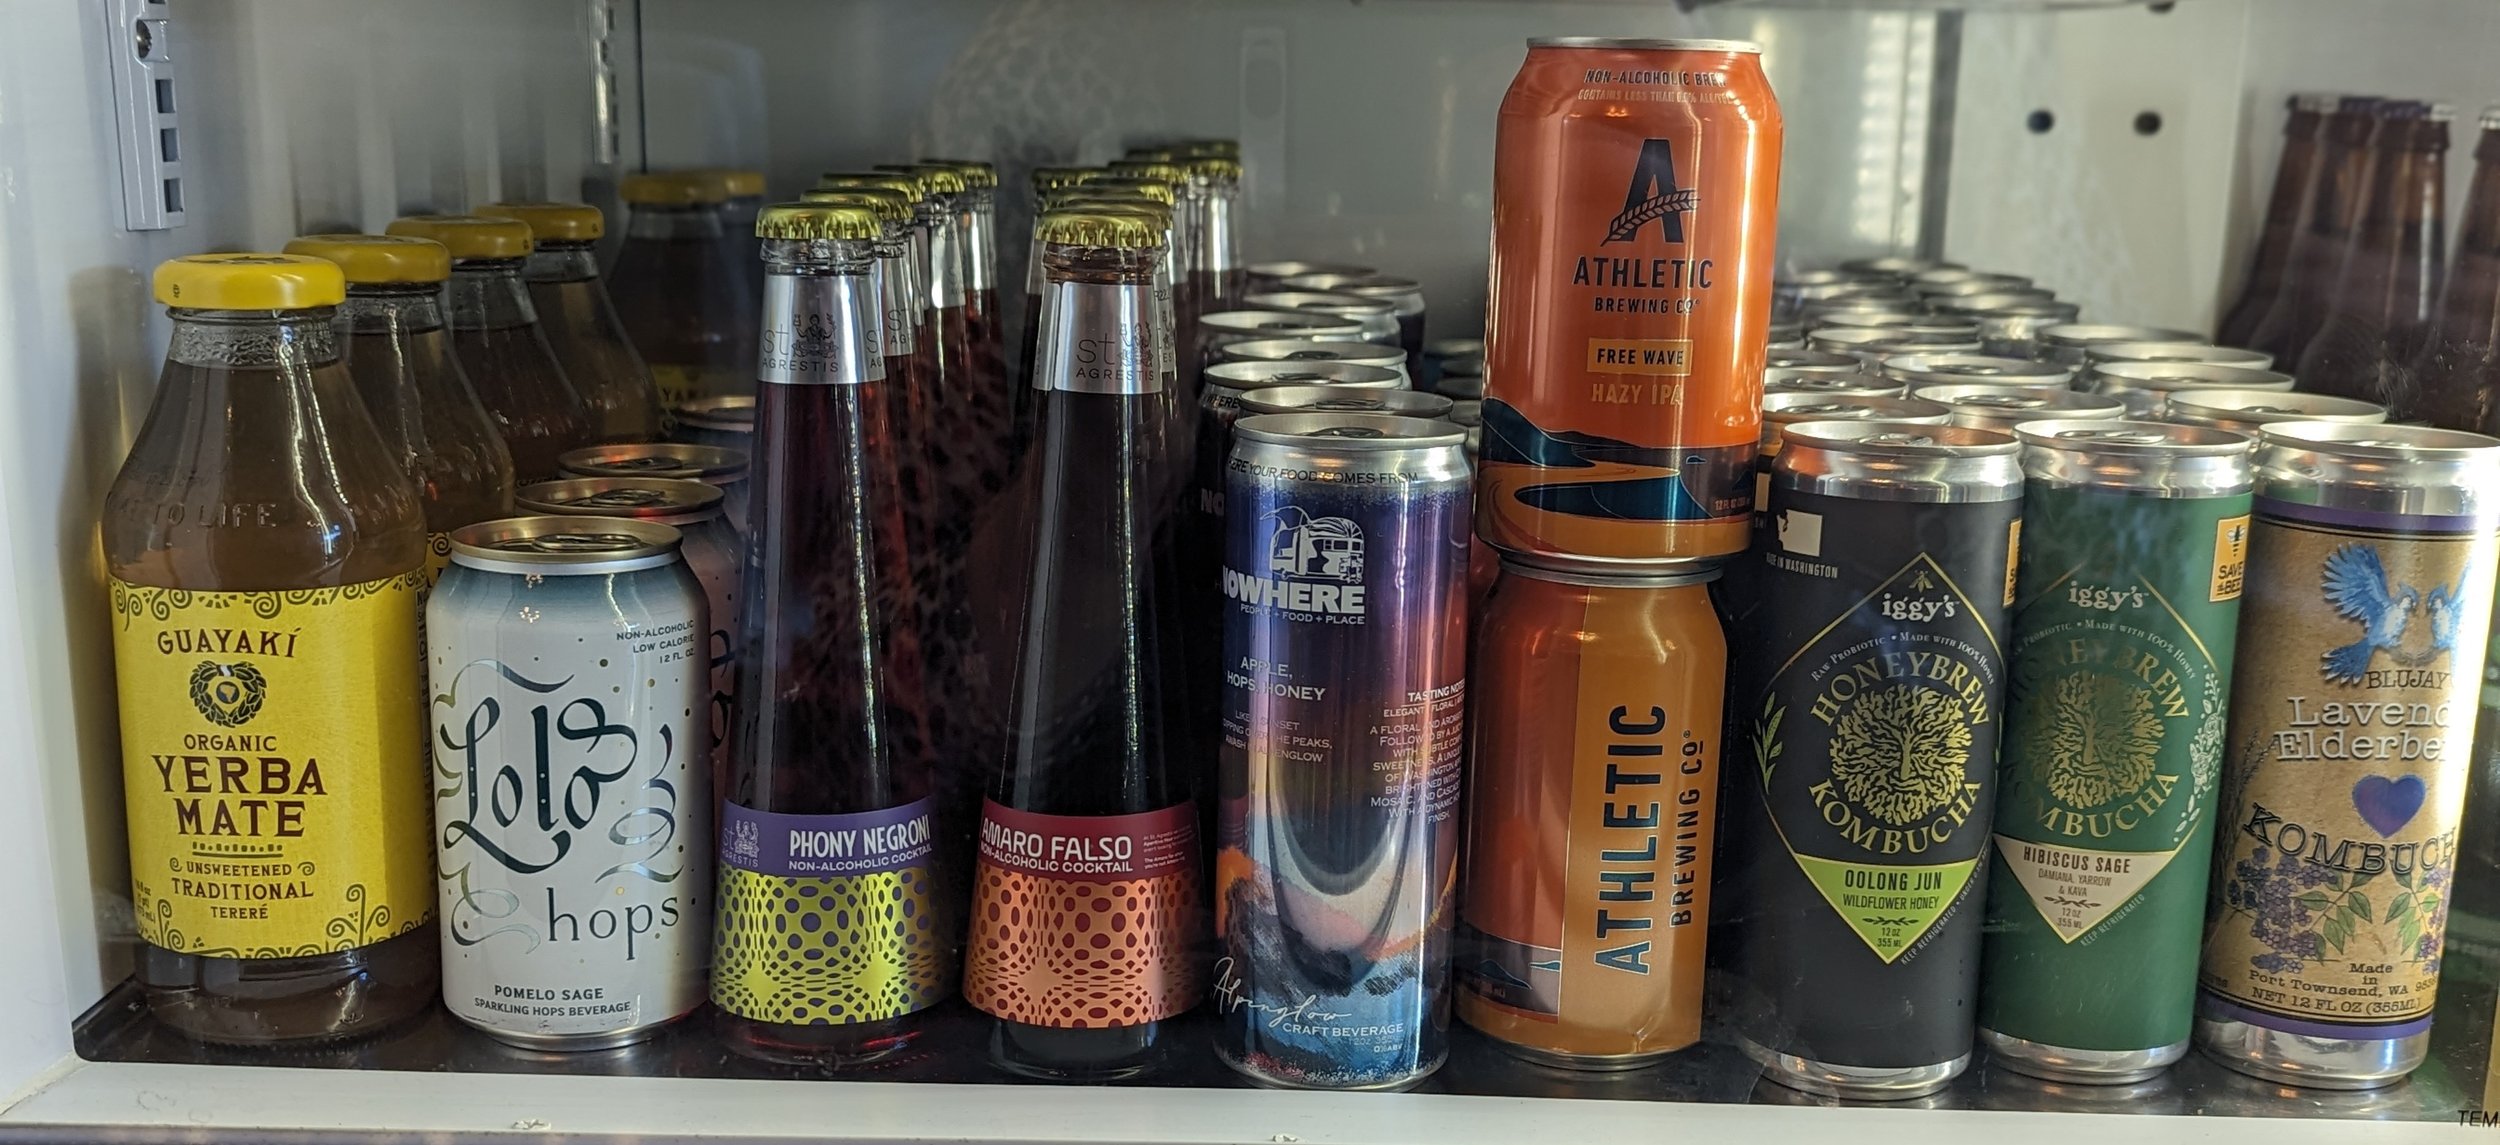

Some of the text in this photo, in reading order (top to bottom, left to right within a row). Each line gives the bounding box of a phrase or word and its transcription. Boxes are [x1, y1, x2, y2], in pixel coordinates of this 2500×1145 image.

[1584, 69, 1690, 86] NON-ALCOHOLIC
[1572, 256, 1713, 289] ATHLETIC
[1595, 298, 1668, 314] BREWING
[762, 358, 838, 372] AGRESTIS
[1597, 348, 1684, 365] FREE WAVE
[1076, 367, 1154, 380] AGRESTIS
[1592, 383, 1684, 405] HAZY IPA
[1249, 463, 1277, 478] YOUR
[1280, 468, 1317, 482] FOOD
[1322, 471, 1376, 484] COMES
[1379, 472, 1418, 484] FROM
[1785, 558, 1838, 579] WASHINGTON
[1222, 565, 1365, 614] NOWHERE
[2068, 580, 2145, 611] iggy's
[1882, 592, 1956, 622] iggy's
[1282, 611, 1313, 623] FOOD
[1326, 615, 1365, 625] PLACE
[616, 620, 694, 640] NON-ALCOHOLIC
[157, 628, 301, 658] GUAYAKÍ
[633, 634, 694, 653] LOW CALORIE
[659, 655, 670, 663] 12
[1240, 656, 1293, 679] APPLE,
[1810, 651, 1990, 726] HONEYBREW
[2366, 670, 2450, 690] BLUJAY
[1263, 682, 1326, 701] HONEY
[1408, 686, 1450, 702] TASTING
[2288, 696, 2450, 728] Lavend
[1261, 717, 1300, 731] SNSET
[184, 735, 277, 751] ORGANIC
[1380, 731, 1435, 747] FOLLOWD
[2275, 729, 2446, 761] Elderbe
[152, 756, 327, 795] YERBA
[1402, 763, 1453, 779] WASINGTON
[1386, 778, 1442, 794] BRGHTNED
[174, 799, 306, 837] MATE
[1808, 779, 1982, 854] KOMBUCHA
[789, 814, 931, 858] PHONY NEGRONI
[982, 817, 1043, 858] AMARO
[1051, 836, 1132, 861] FALSO
[1593, 704, 1667, 977] ATHLETIC
[2242, 802, 2457, 875] KOMBUCH
[788, 844, 932, 871] NON-ALCOHOLIC COCKTAIL
[980, 843, 1133, 874] NON-ALCOHOLIC COCKTAIL
[1669, 787, 1700, 928] BREWING
[2024, 846, 2131, 874] HIBISCUS SAGE
[187, 861, 292, 876] UNSWEETENED
[171, 878, 314, 899] TRADITIONAL
[1844, 869, 1942, 891] OOLONG JUN
[2079, 874, 2112, 887] YARROW
[1843, 893, 1939, 910] WILDFLOWER HONEY
[2067, 886, 2088, 897] KAVA
[211, 904, 268, 919] TERERÉ
[546, 887, 679, 960] hops
[1881, 927, 1891, 936] 12
[2349, 963, 2393, 974] Made
[2249, 969, 2285, 987] Port
[2290, 979, 2382, 998] Townsend,
[2389, 986, 2408, 995] WA
[2362, 976, 2378, 985] in
[494, 985, 604, 1000] POMELO SAGE
[1214, 957, 1352, 1027] Alpenglow
[2252, 987, 2286, 1001] NET
[2291, 995, 2310, 1006] 12
[2314, 1000, 2336, 1012] FL
[2341, 1002, 2362, 1013] OZ
[475, 998, 631, 1017] SPARKLING HOPS BEVERAGE
[1283, 1022, 1404, 1037] CRAFT BEVERAGE
